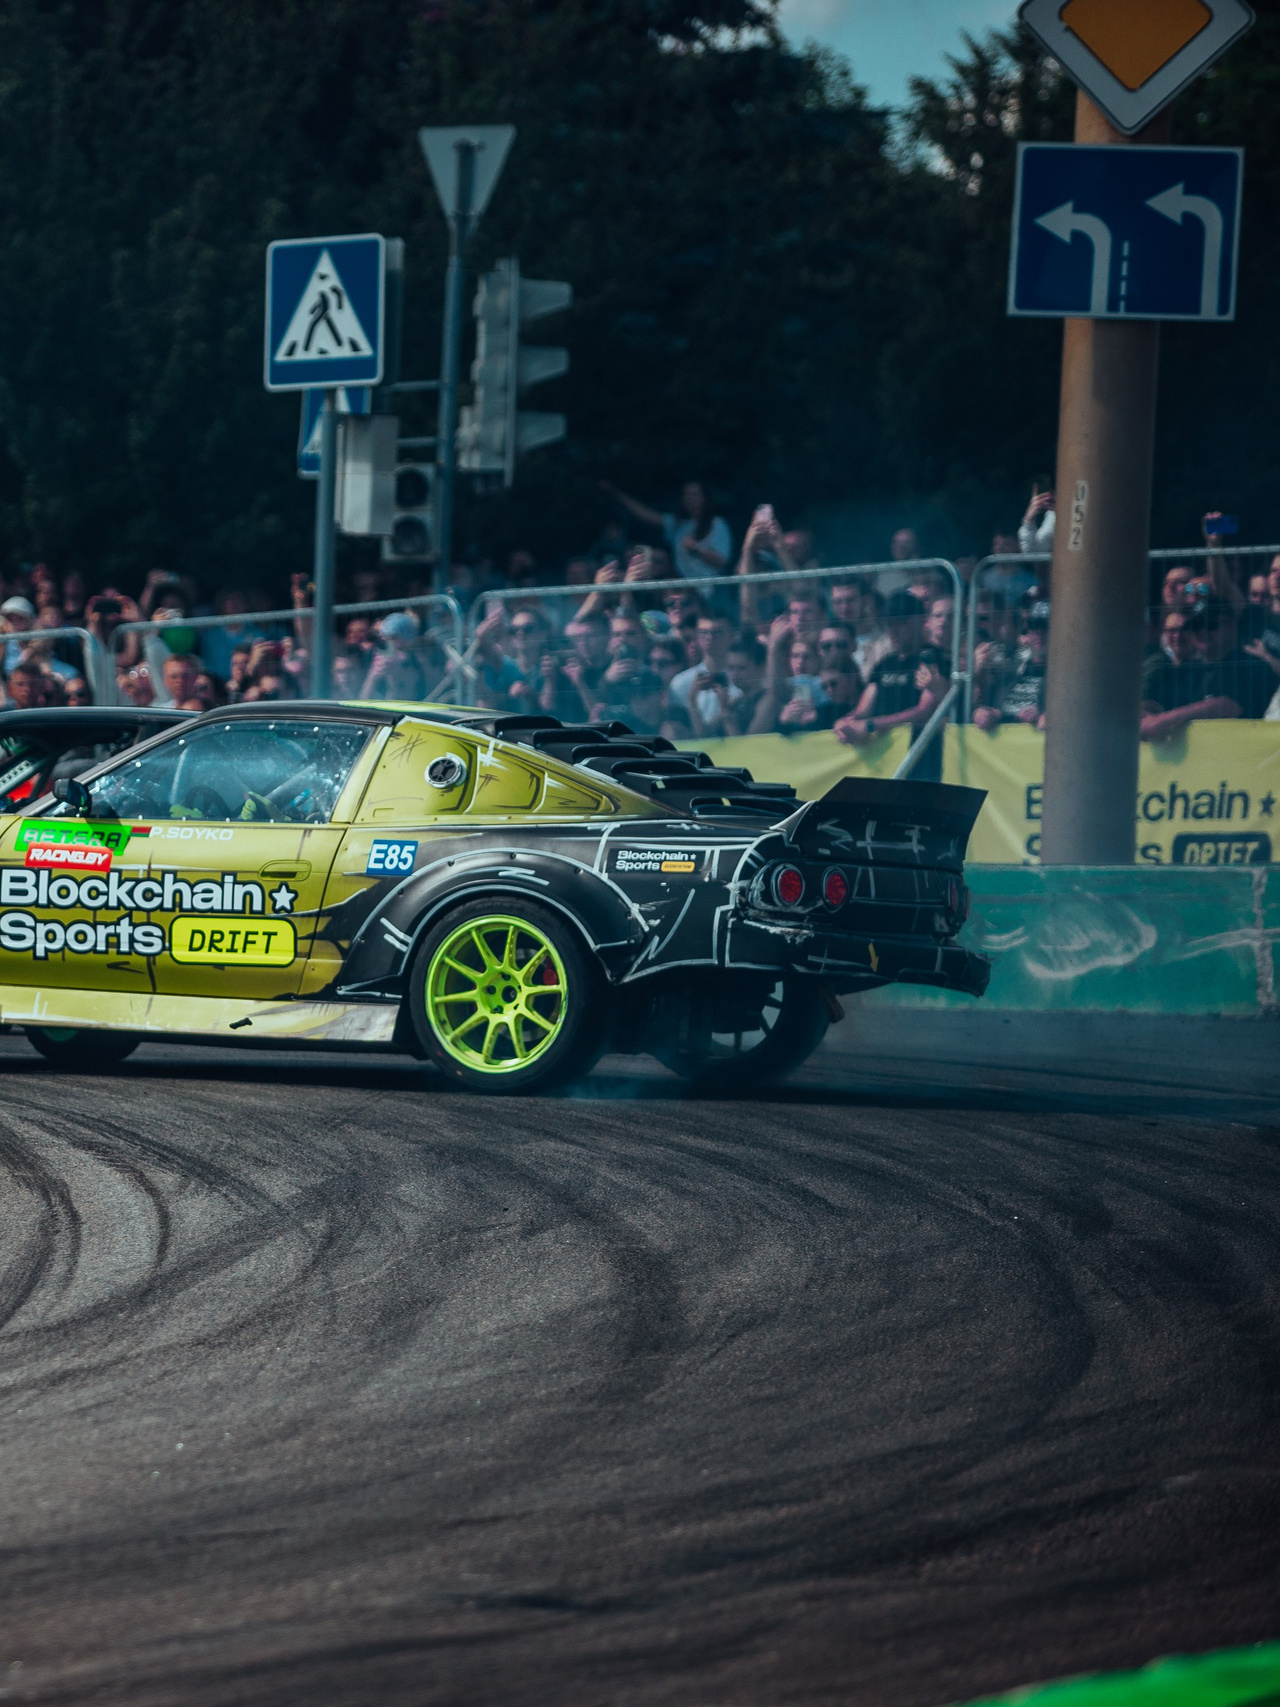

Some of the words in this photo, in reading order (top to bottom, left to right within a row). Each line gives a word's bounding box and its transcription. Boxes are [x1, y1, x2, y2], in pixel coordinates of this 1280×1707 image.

[1025, 780, 1250, 821] Bchain
[149, 826, 234, 841] P.SOYKO
[367, 844, 415, 871] E85
[615, 860, 660, 871] Sports
[617, 850, 689, 861] Blockchain
[0, 868, 264, 912] Blockchain
[187, 928, 278, 955] DRIFT
